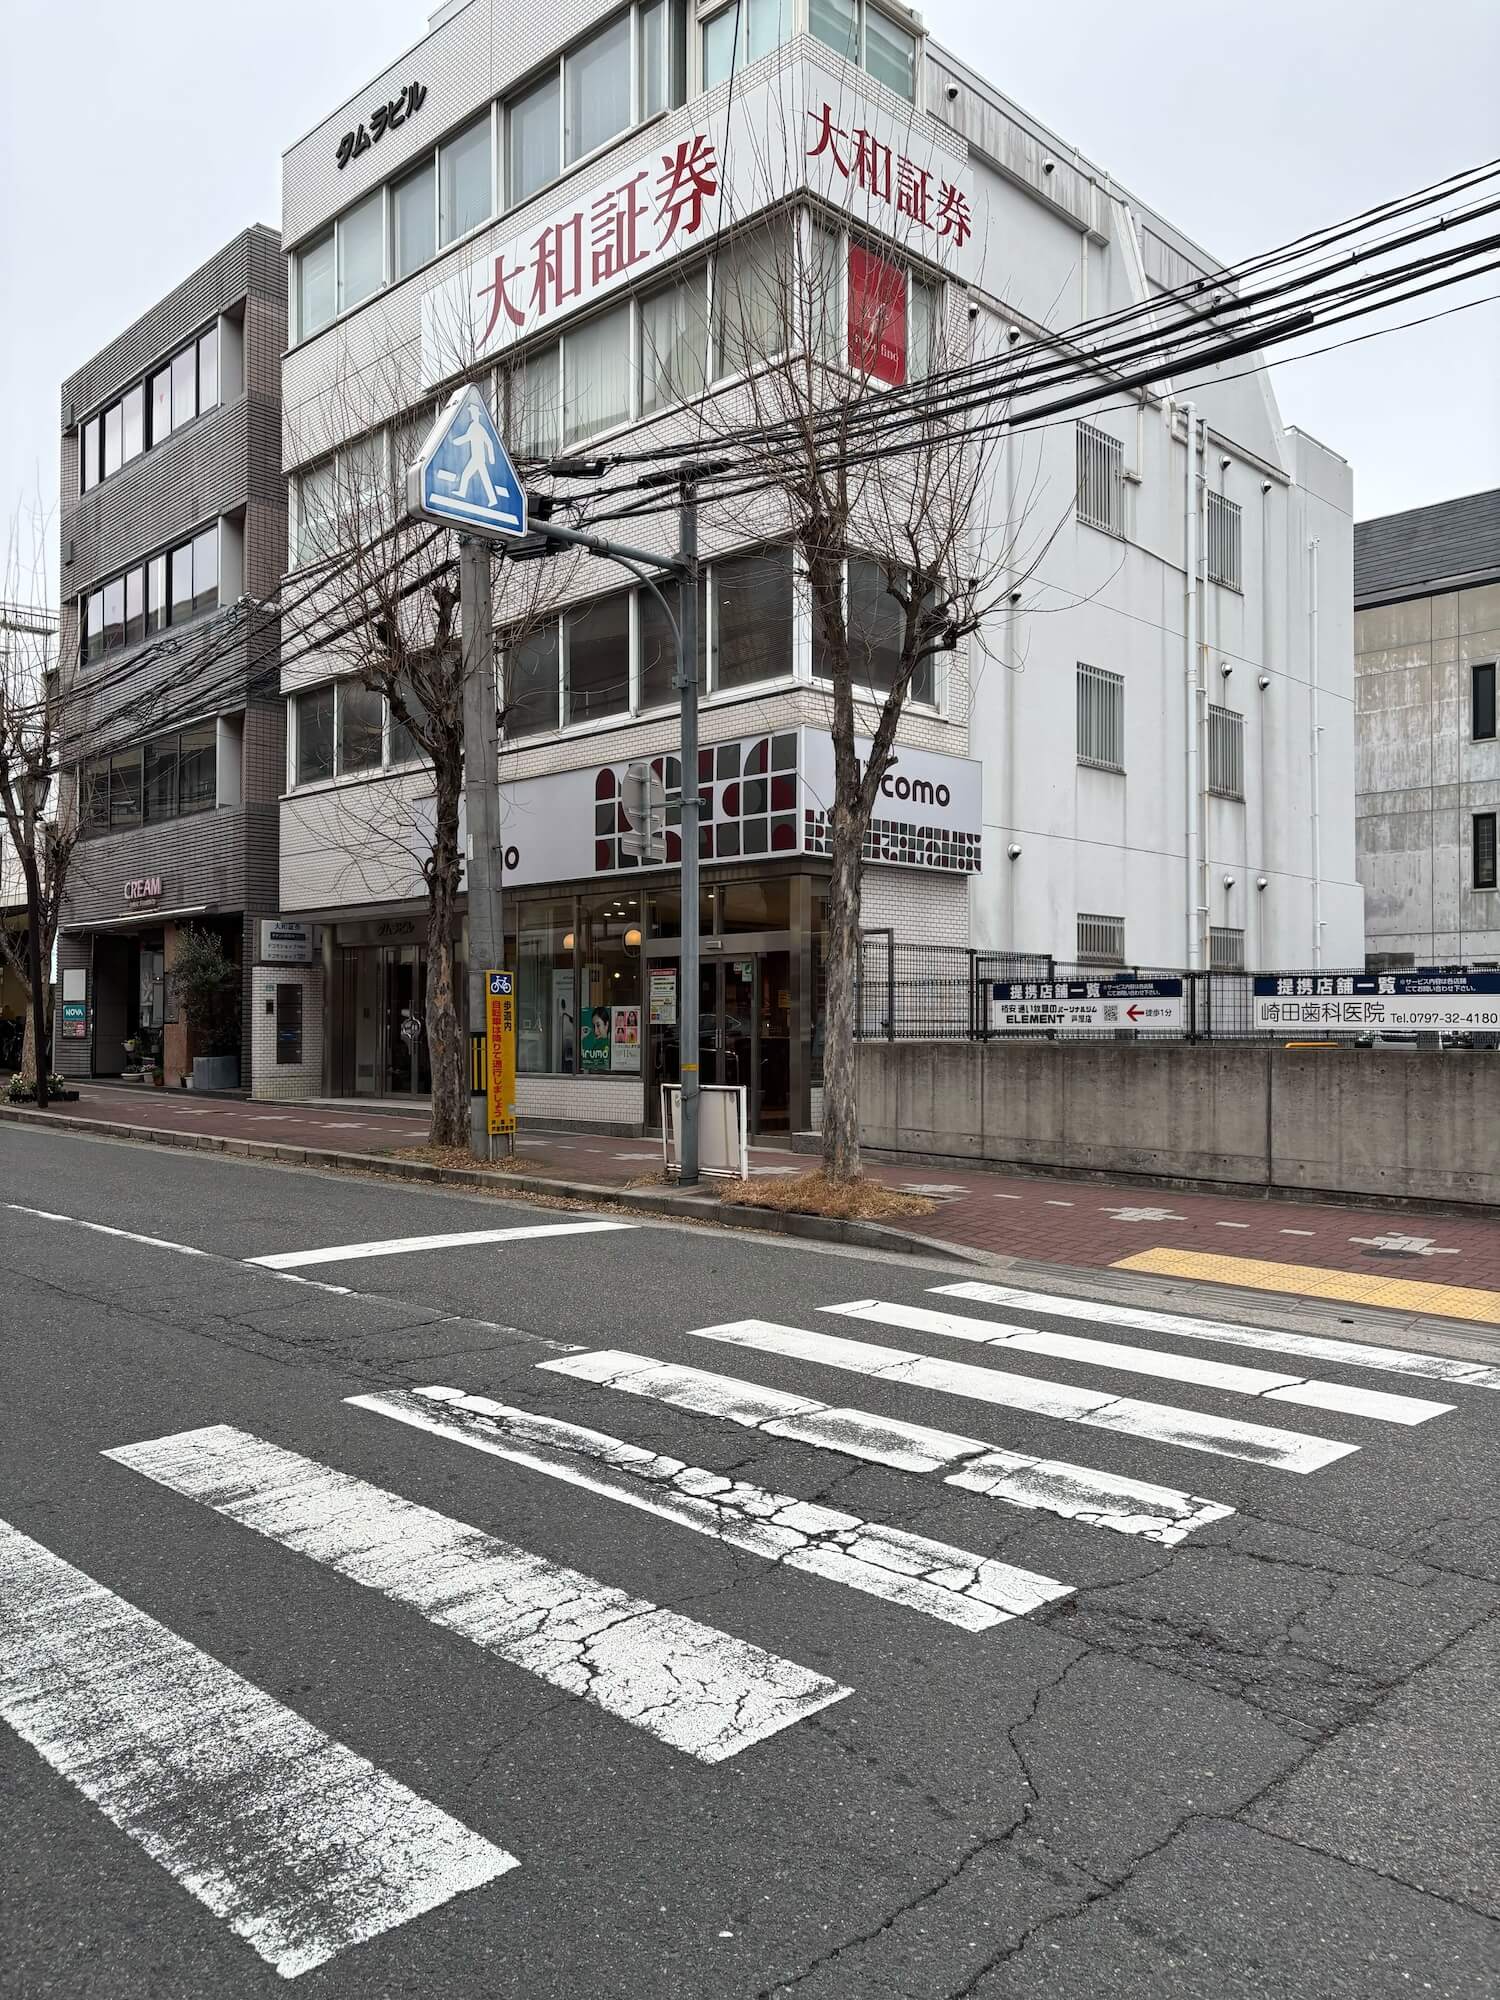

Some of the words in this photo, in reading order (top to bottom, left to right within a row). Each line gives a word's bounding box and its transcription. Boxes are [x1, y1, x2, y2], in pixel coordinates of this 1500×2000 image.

[335, 81, 427, 170] タムラビル
[806, 102, 972, 247] 大和証券
[476, 134, 718, 352] 大和証券
[124, 877, 161, 899] CREAM
[1010, 982, 1101, 1000] 提携店舗一覧
[1276, 976, 1397, 996] 提携店舗一覧
[65, 1008, 84, 1018] NOVA
[503, 1000, 512, 1032] 歩道内
[1006, 1014, 1065, 1024] ELEMENT
[1145, 1009, 1173, 1017] 徒歩1分
[1261, 1001, 1385, 1023] 崎田歯科医院
[1390, 1012, 1498, 1024] Tel.0797-32-4180
